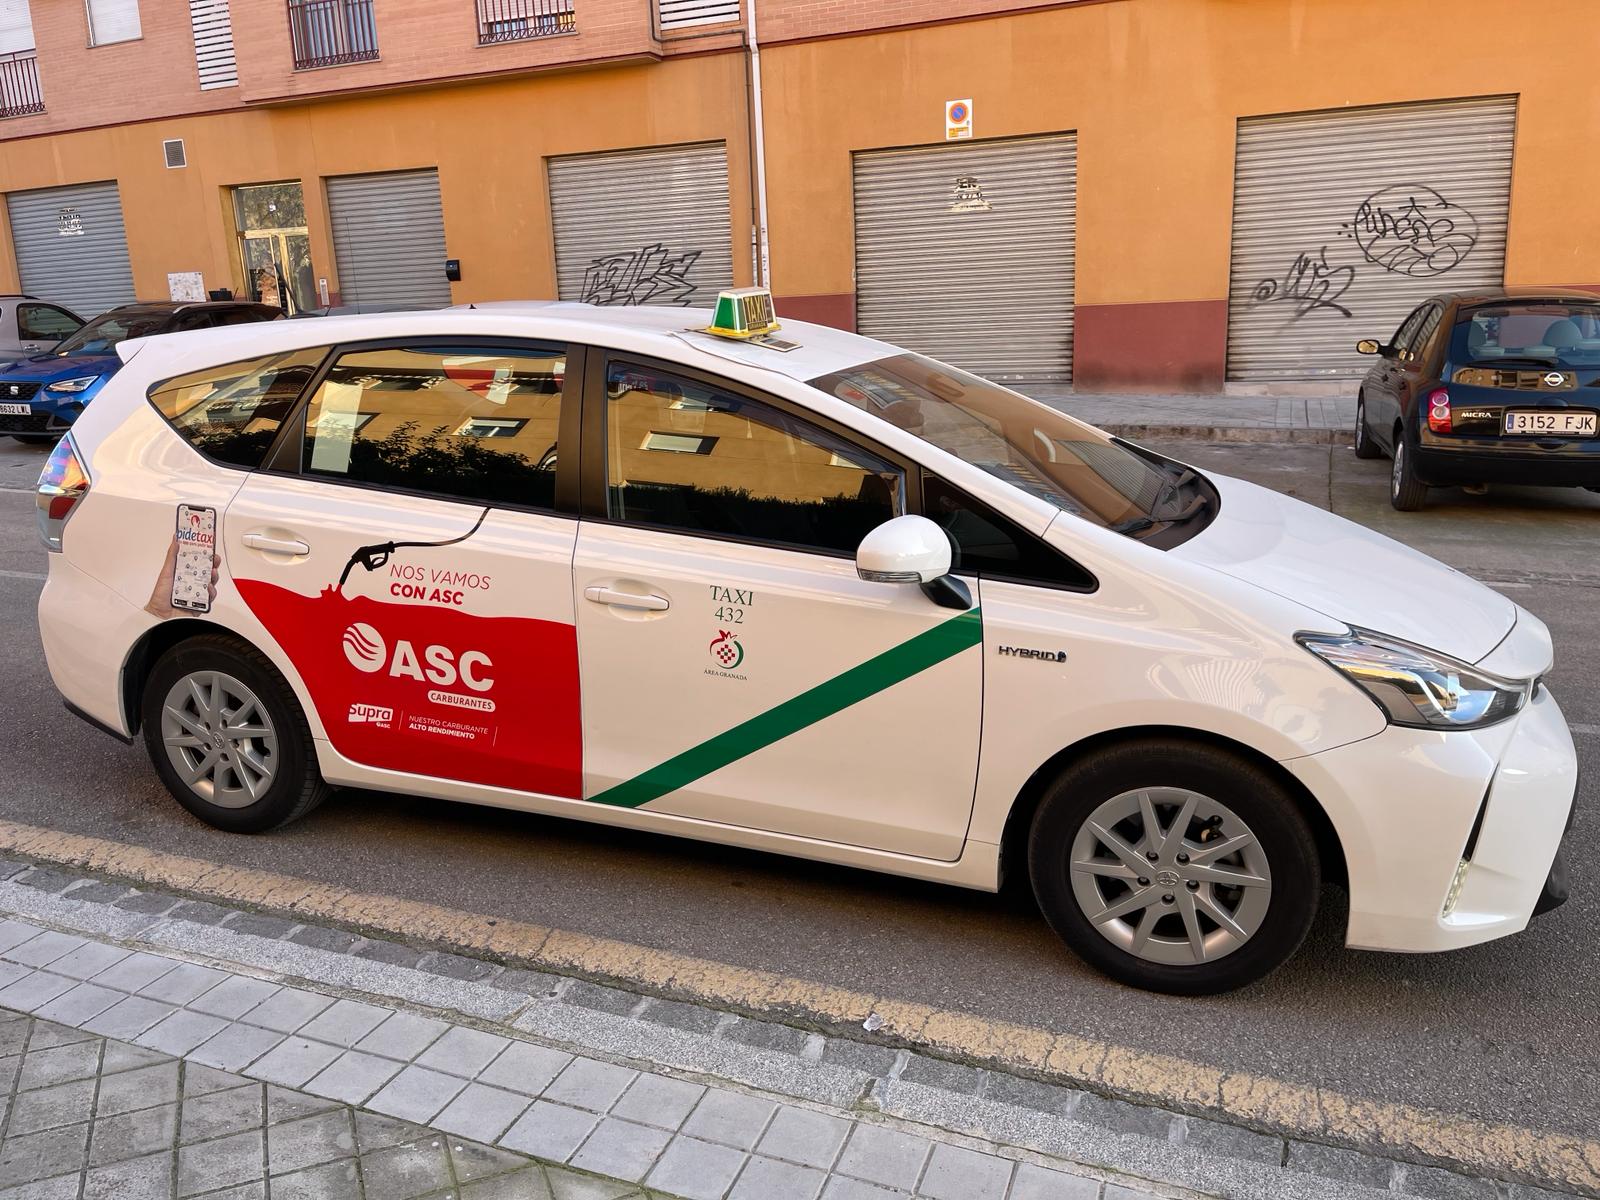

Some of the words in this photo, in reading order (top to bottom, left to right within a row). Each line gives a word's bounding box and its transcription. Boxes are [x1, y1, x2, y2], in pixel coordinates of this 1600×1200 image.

[744, 295, 766, 322] TAXI
[1518, 416, 1555, 429] 3152
[1565, 416, 1594, 430] FJK
[390, 564, 426, 581] NOS
[431, 568, 491, 590] VAMOS
[390, 582, 426, 600] CON
[429, 588, 464, 605] ASC
[710, 585, 754, 606] TAXI
[714, 606, 744, 624] 432
[998, 645, 1056, 662] HYBRID
[389, 639, 495, 692] ASC
[719, 671, 748, 681] GRANADA
[430, 692, 492, 710] CARBURANTES
[408, 715, 441, 726] NUESTRO
[442, 720, 489, 735] CARBURANTE
[408, 722, 427, 731] ALTO
[427, 725, 475, 740] RENDIMIENTO
